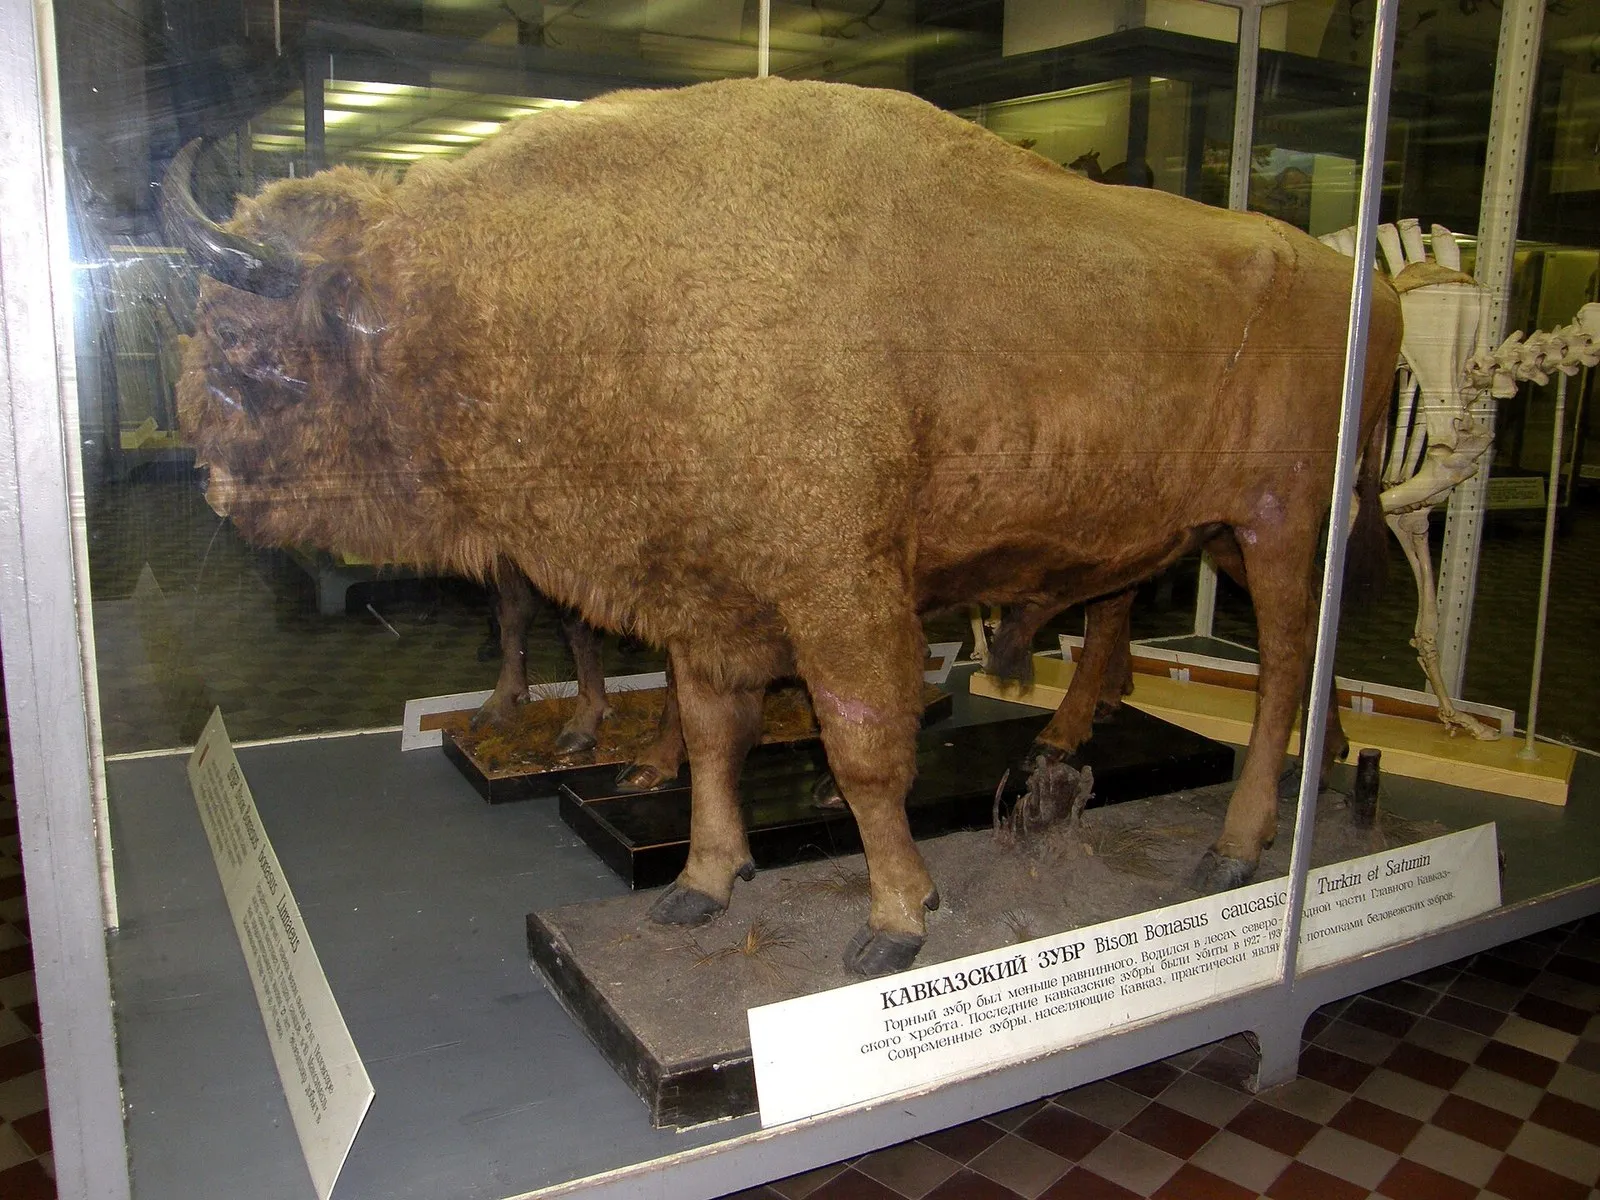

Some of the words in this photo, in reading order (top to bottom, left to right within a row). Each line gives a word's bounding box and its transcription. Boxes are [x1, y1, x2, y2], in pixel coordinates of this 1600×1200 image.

[276, 893, 300, 954] Linnaeus
[860, 1036, 901, 1054] ского
[909, 1020, 963, 1041] хребта.
[969, 997, 1038, 1024] Последние
[1045, 976, 1115, 1003] кавказские
[1120, 963, 1155, 982] зубры
[1161, 955, 1190, 970] были
[1196, 945, 1228, 961] убиты
[1233, 942, 1240, 950] в
[880, 954, 1028, 1010] КАВКАЗСКИЙ
[1038, 942, 1085, 968] ЗУБР
[1094, 932, 1138, 954] Bison
[1143, 913, 1208, 941] Bonasus
[1221, 892, 1287, 920] caucasic
[1317, 873, 1361, 895] Turkin
[1367, 865, 1379, 881] et
[1385, 854, 1430, 876] Satunin
[884, 1009, 937, 1032] Горный
[943, 1000, 971, 1017] зубр
[976, 993, 1002, 1007] был
[1008, 978, 1058, 999] меньше
[1061, 958, 1137, 986] равнинного.
[1141, 942, 1190, 962] Водился
[1194, 940, 1200, 948] в
[1204, 930, 1236, 945] лесах
[1335, 893, 1366, 907] части
[1371, 880, 1414, 898] Главного
[888, 1028, 982, 1061] Современные
[1035, 990, 1114, 1020] населяющие
[1171, 952, 1246, 982] практически
[1307, 919, 1364, 941] потомками
[1367, 900, 1425, 924] беловежских
